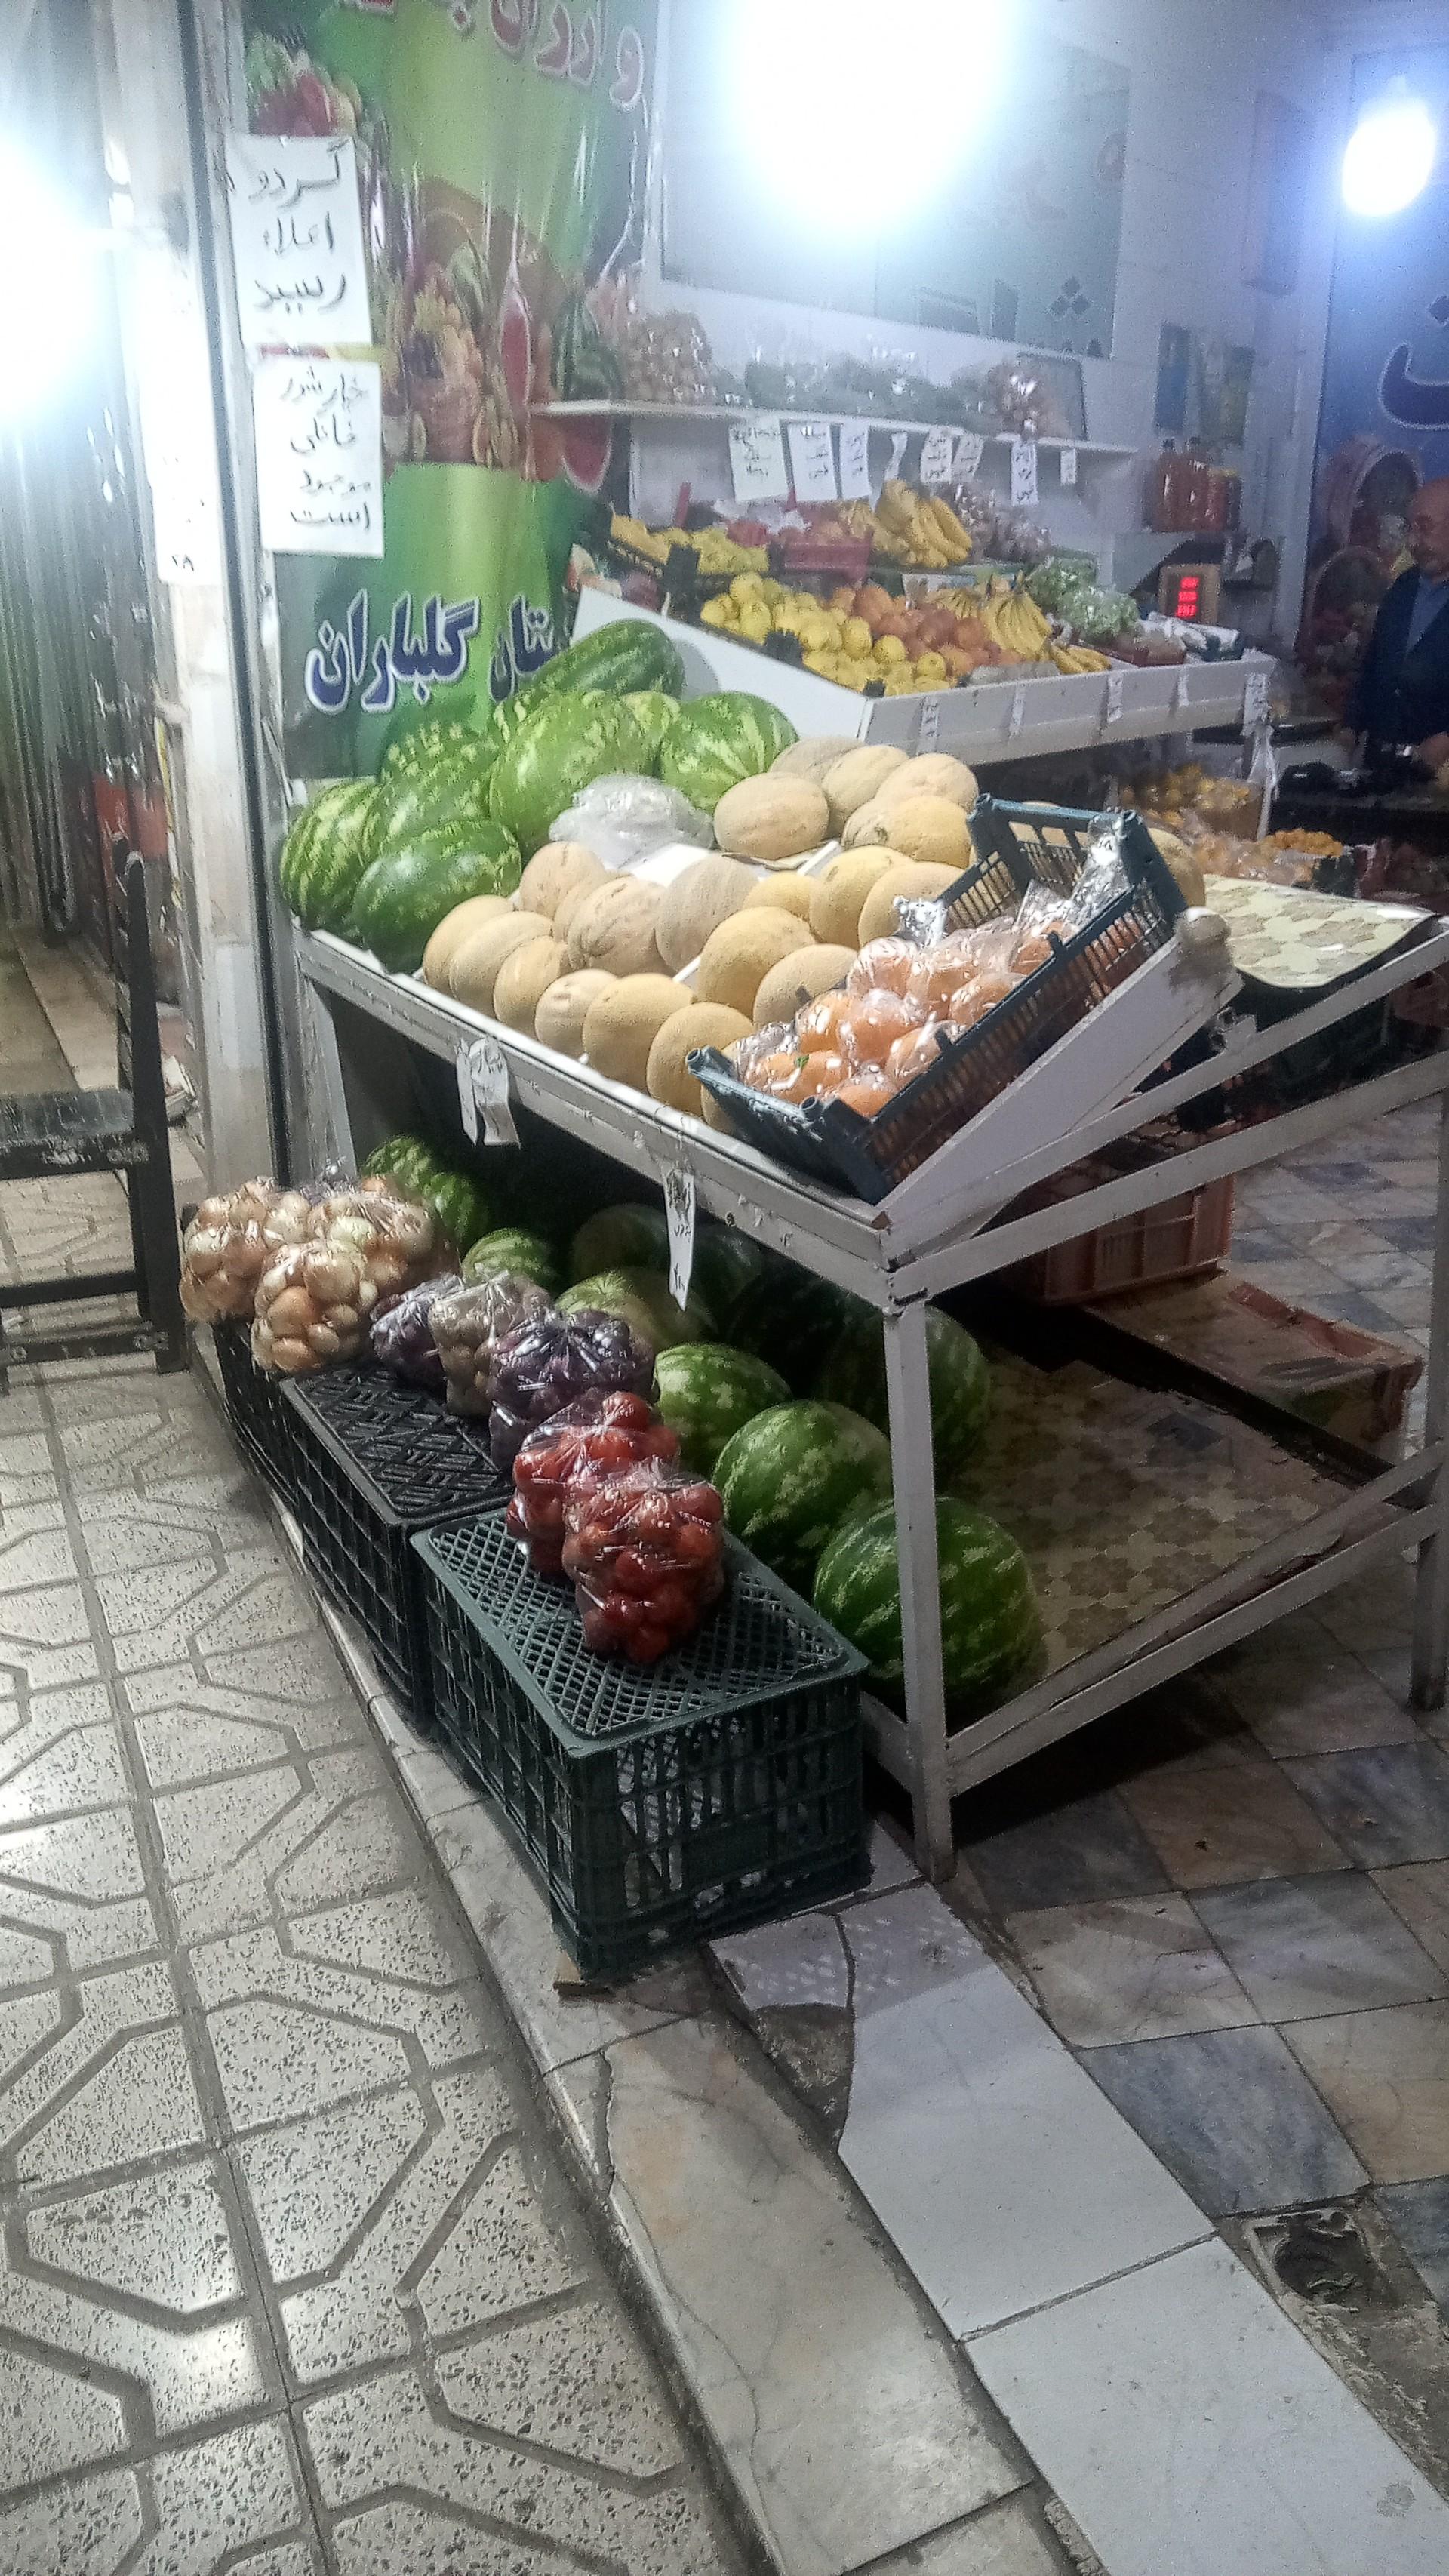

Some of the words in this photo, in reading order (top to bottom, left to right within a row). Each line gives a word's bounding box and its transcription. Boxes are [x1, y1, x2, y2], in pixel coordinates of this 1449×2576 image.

[248, 138, 350, 209] گردو
[252, 274, 346, 314] رسید
[290, 502, 370, 530] است
[305, 588, 480, 715] گلباران
